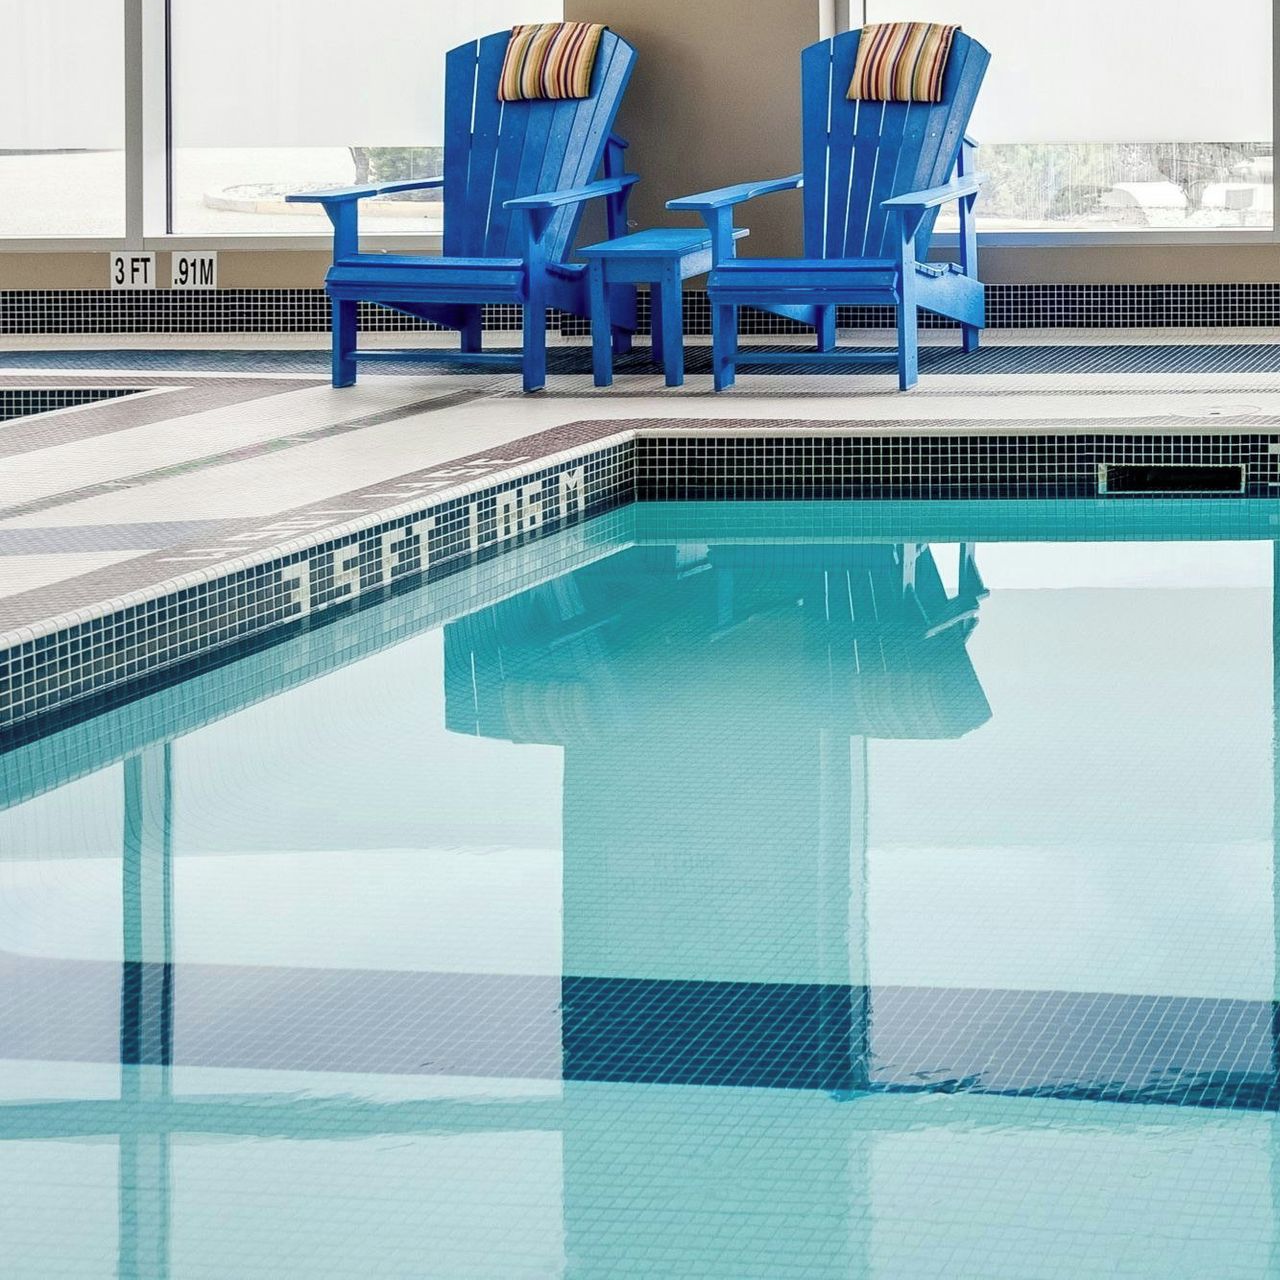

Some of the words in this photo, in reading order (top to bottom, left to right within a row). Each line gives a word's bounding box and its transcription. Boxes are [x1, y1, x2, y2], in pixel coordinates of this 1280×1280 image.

[115, 257, 125, 285] 3
[130, 257, 151, 284] FT
[174, 257, 214, 285] .91M
[382, 517, 436, 587] FT
[560, 466, 585, 519] M
